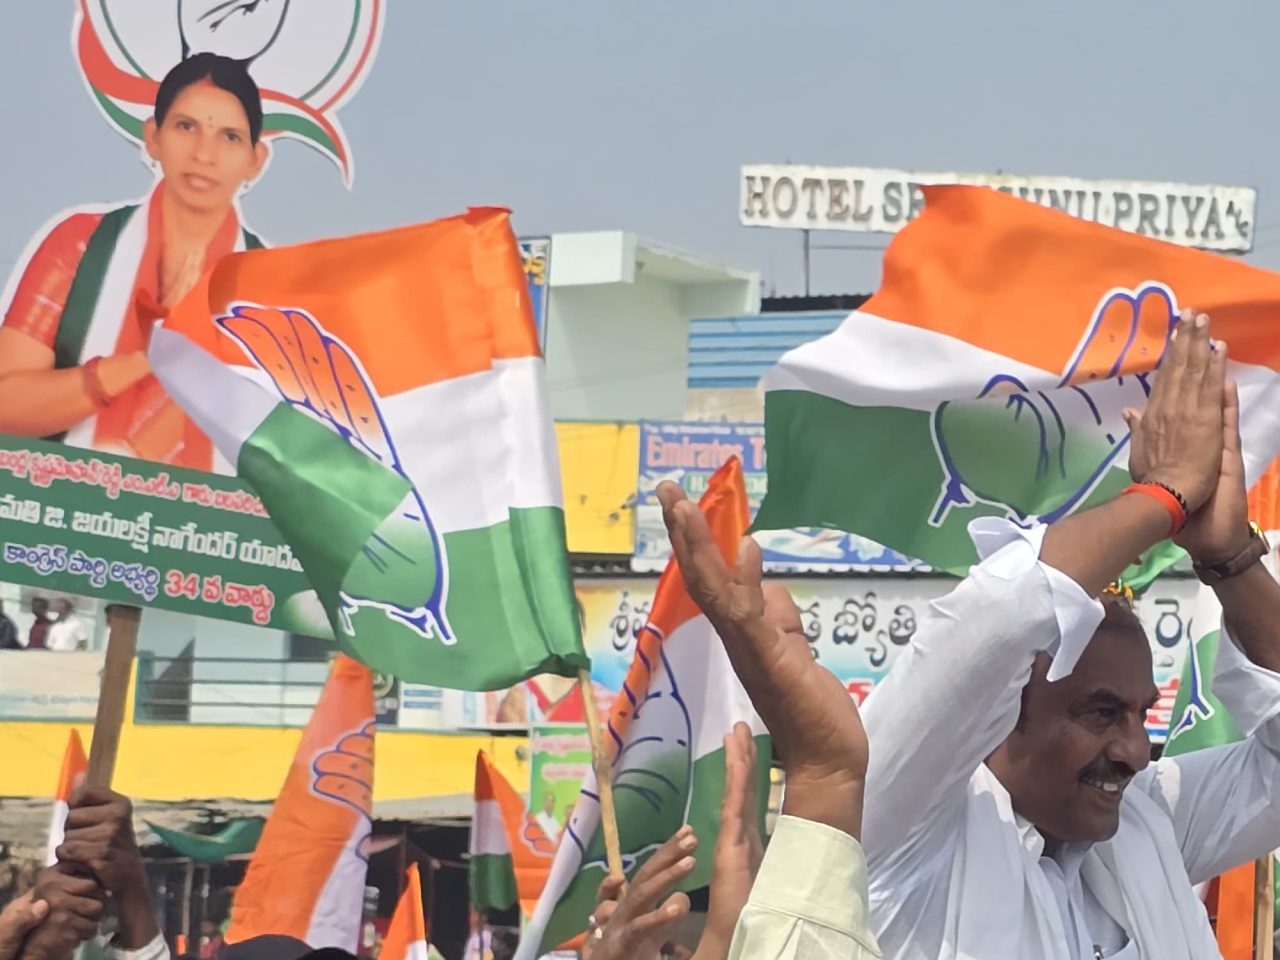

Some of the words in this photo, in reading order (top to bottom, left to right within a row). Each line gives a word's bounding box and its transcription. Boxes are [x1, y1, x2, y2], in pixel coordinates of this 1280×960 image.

[744, 175, 874, 223] HOTEL
[881, 180, 926, 224] SR
[1112, 191, 1226, 238] PRIYA
[164, 569, 199, 599] 34
[223, 583, 276, 626] వార్డు
[832, 591, 918, 667] జ్యోతి
